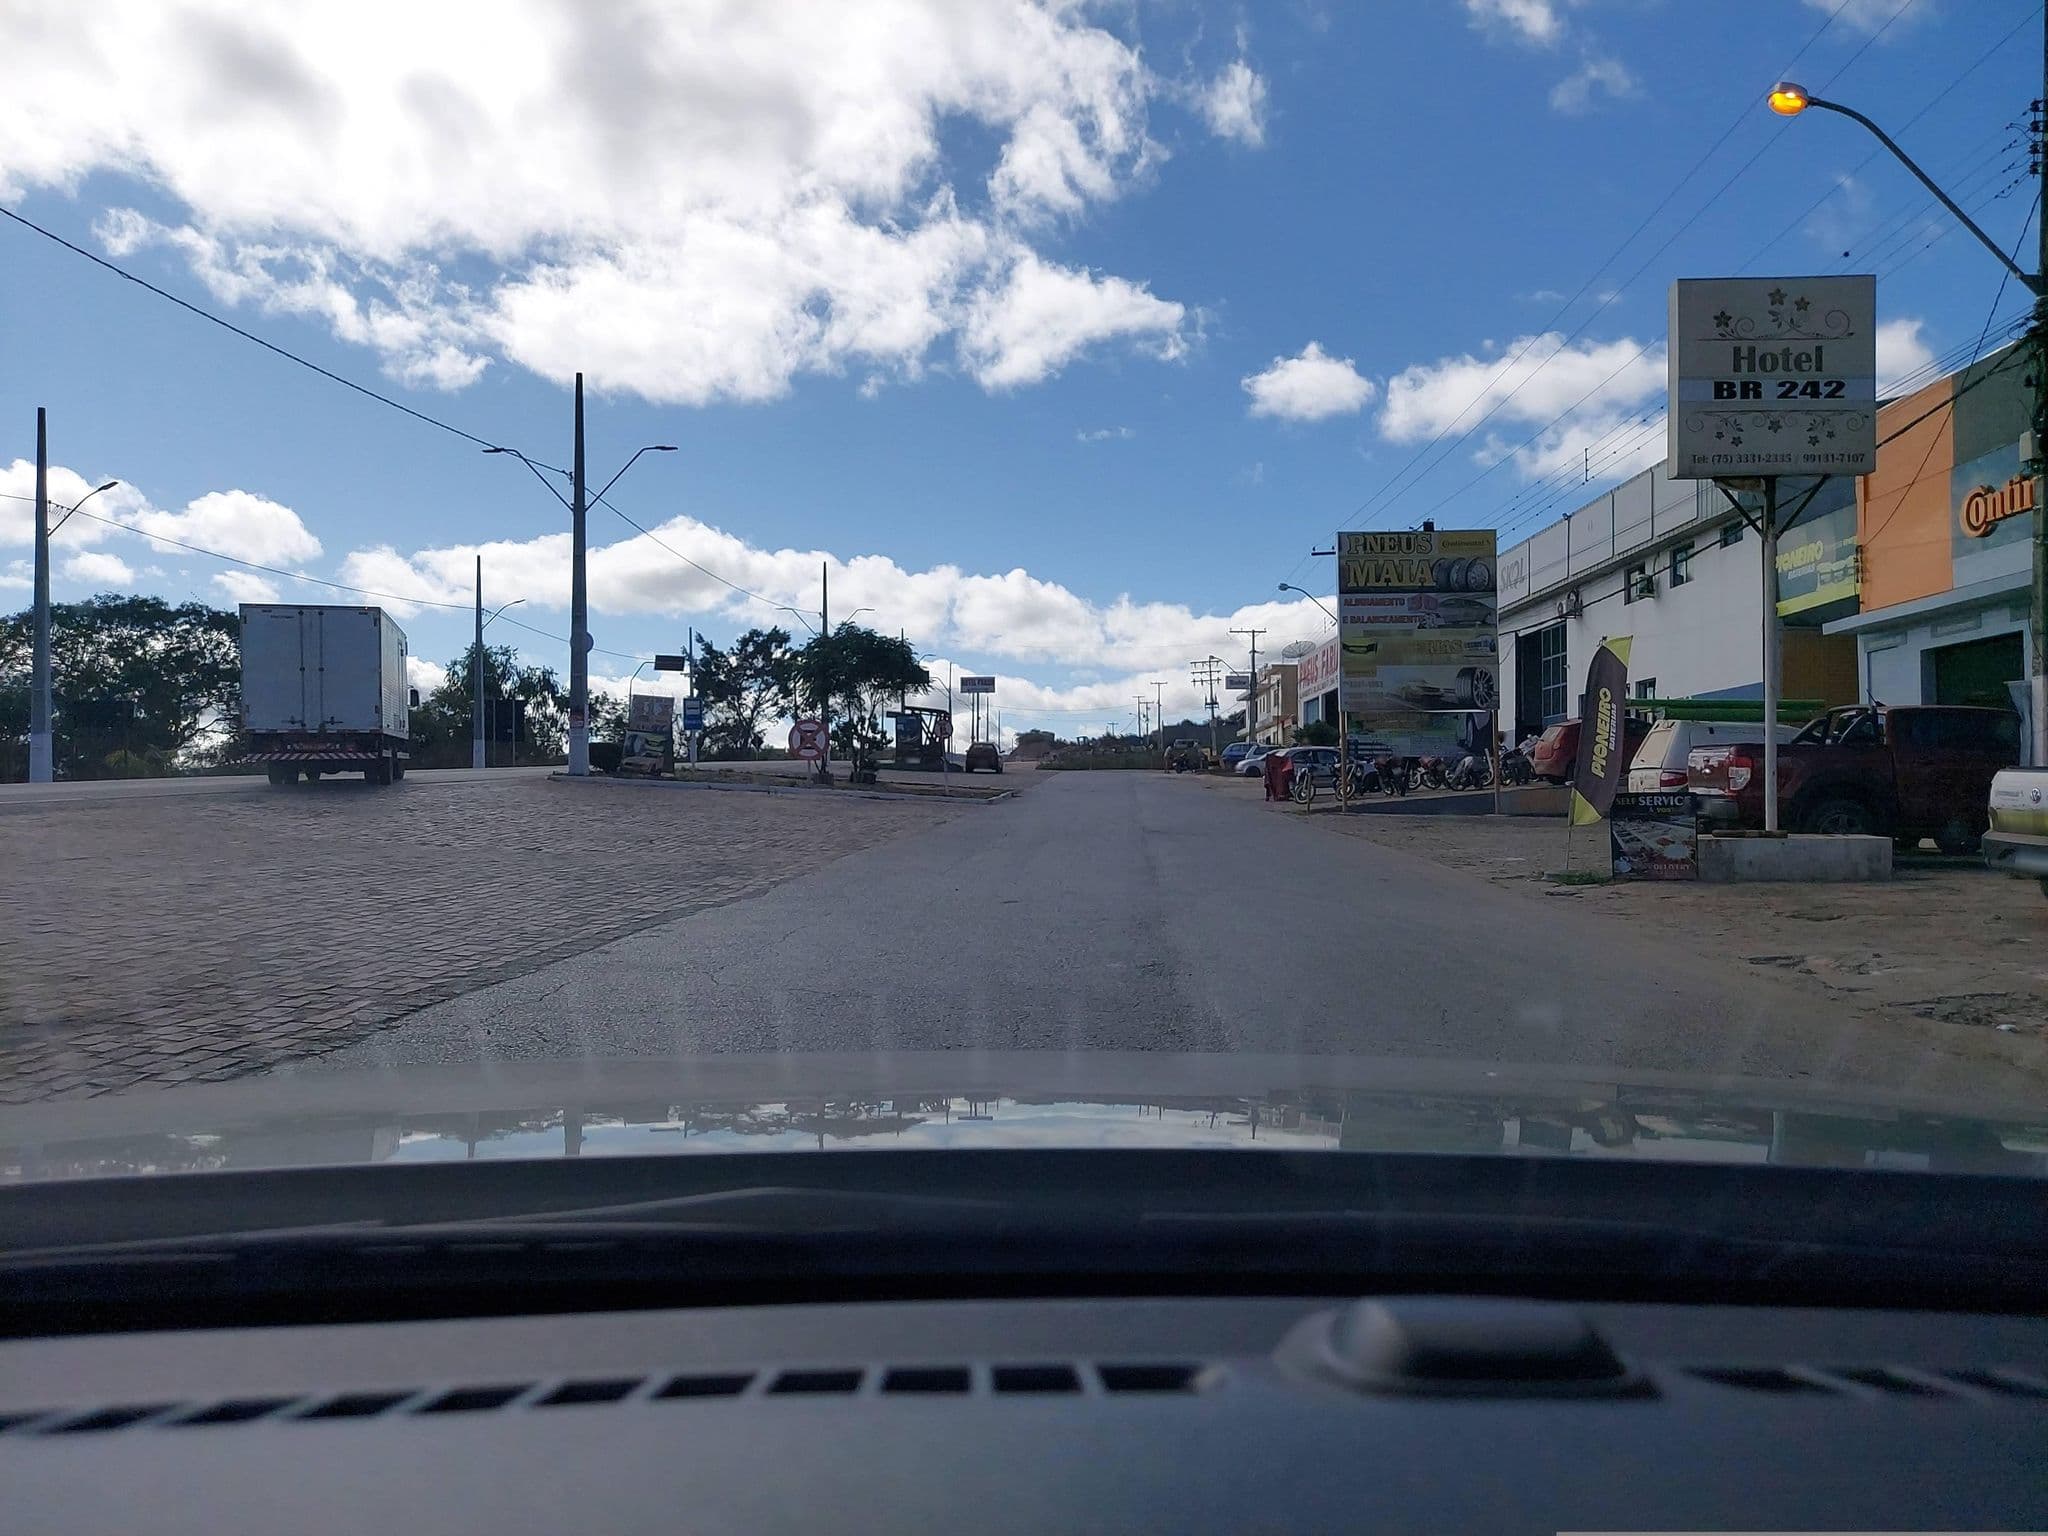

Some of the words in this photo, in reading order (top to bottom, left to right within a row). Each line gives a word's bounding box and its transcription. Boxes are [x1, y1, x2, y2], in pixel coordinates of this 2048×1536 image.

[1732, 345, 1824, 373] Hotel
[1713, 380, 1763, 400] BR
[1776, 379, 1846, 400] 242
[1691, 454, 1709, 466] Tel:
[1711, 454, 1733, 466] (75)
[1347, 533, 1433, 554] PNEUS
[1346, 559, 1437, 587] MAIA
[1590, 686, 1613, 779] PIONEIRO
[1608, 702, 1618, 752] BATERIAS
